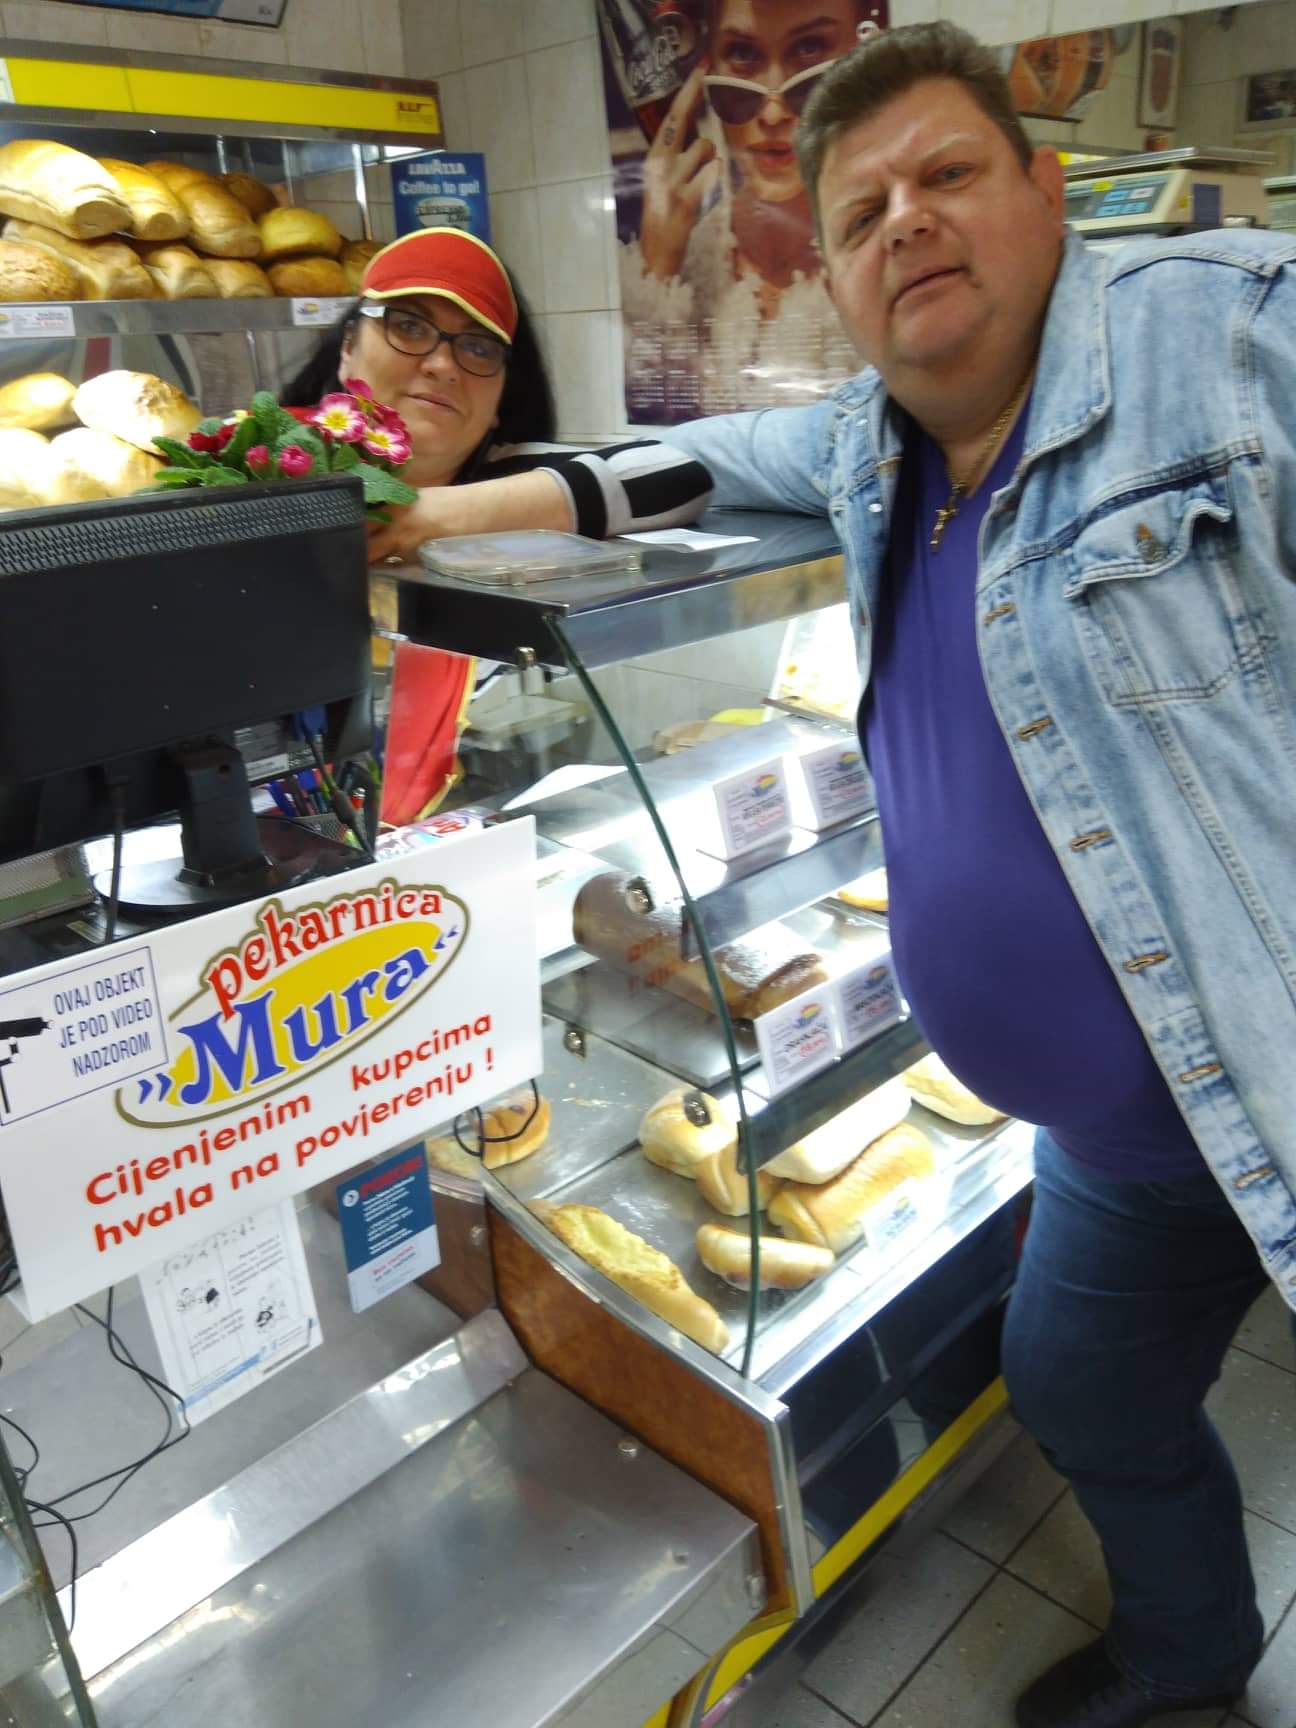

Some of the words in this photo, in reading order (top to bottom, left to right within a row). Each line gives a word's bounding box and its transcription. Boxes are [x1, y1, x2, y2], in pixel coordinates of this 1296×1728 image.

[443, 181, 456, 194] to
[208, 886, 441, 1020] pekarnica
[54, 986, 90, 1015] OVAJ
[94, 967, 145, 1001] OBJEKT
[60, 1025, 76, 1048] JE
[79, 1014, 108, 1042] POD
[111, 998, 153, 1029] VIDEO
[72, 1032, 151, 1077] NADZOROM
[86, 1091, 311, 1205] Cijenjenim
[351, 1014, 492, 1091] kupcima
[94, 1182, 213, 1252] hvala
[231, 1151, 279, 1190] na
[295, 1057, 473, 1168] povjerenju
